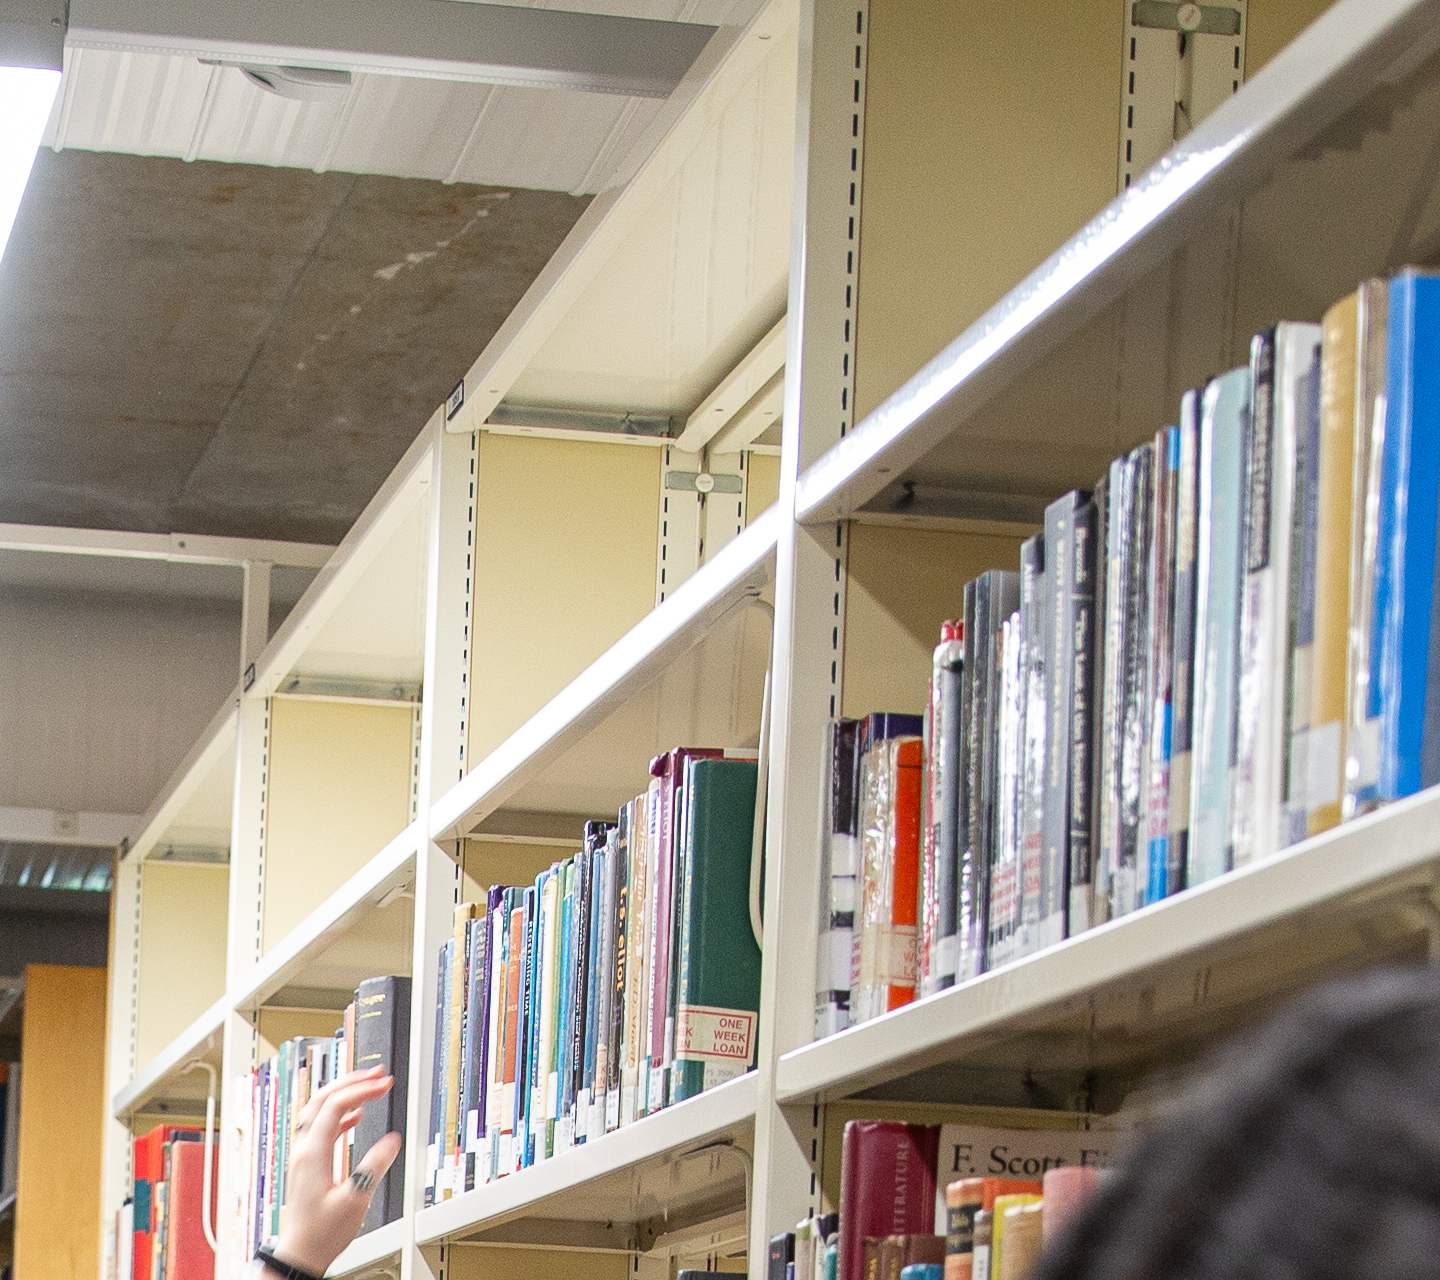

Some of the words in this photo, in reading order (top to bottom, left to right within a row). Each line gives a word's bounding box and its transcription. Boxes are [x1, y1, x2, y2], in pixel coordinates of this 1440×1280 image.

[719, 1018, 743, 1029] ONE
[713, 1030, 747, 1043] WEEK
[713, 1043, 744, 1054] LOAN
[951, 1144, 976, 1173] F.
[987, 1145, 1065, 1176] Scott
